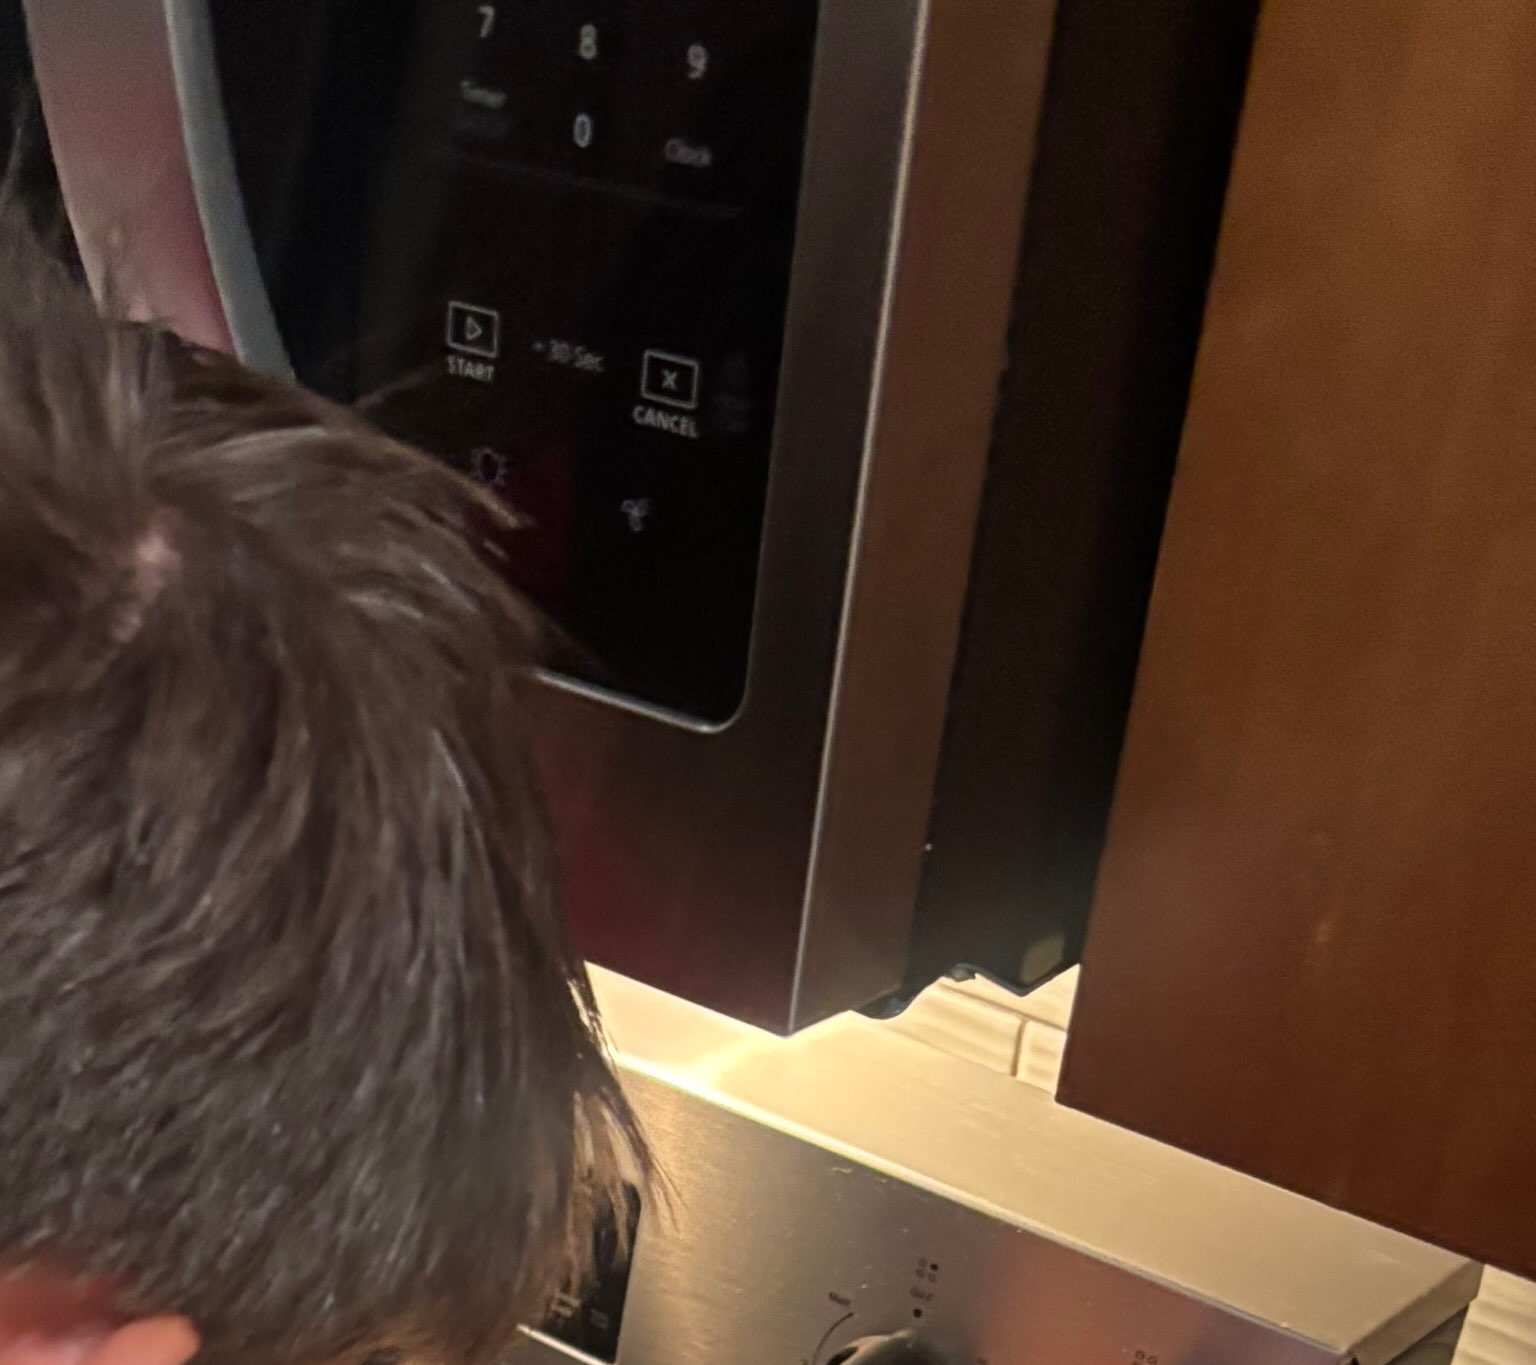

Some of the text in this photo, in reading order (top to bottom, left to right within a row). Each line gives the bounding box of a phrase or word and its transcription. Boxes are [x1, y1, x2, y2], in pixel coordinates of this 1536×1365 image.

[478, 5, 707, 80] 7 8 9
[573, 113, 592, 147] 0
[447, 355, 495, 382] START
[631, 405, 699, 439] CANCEL
